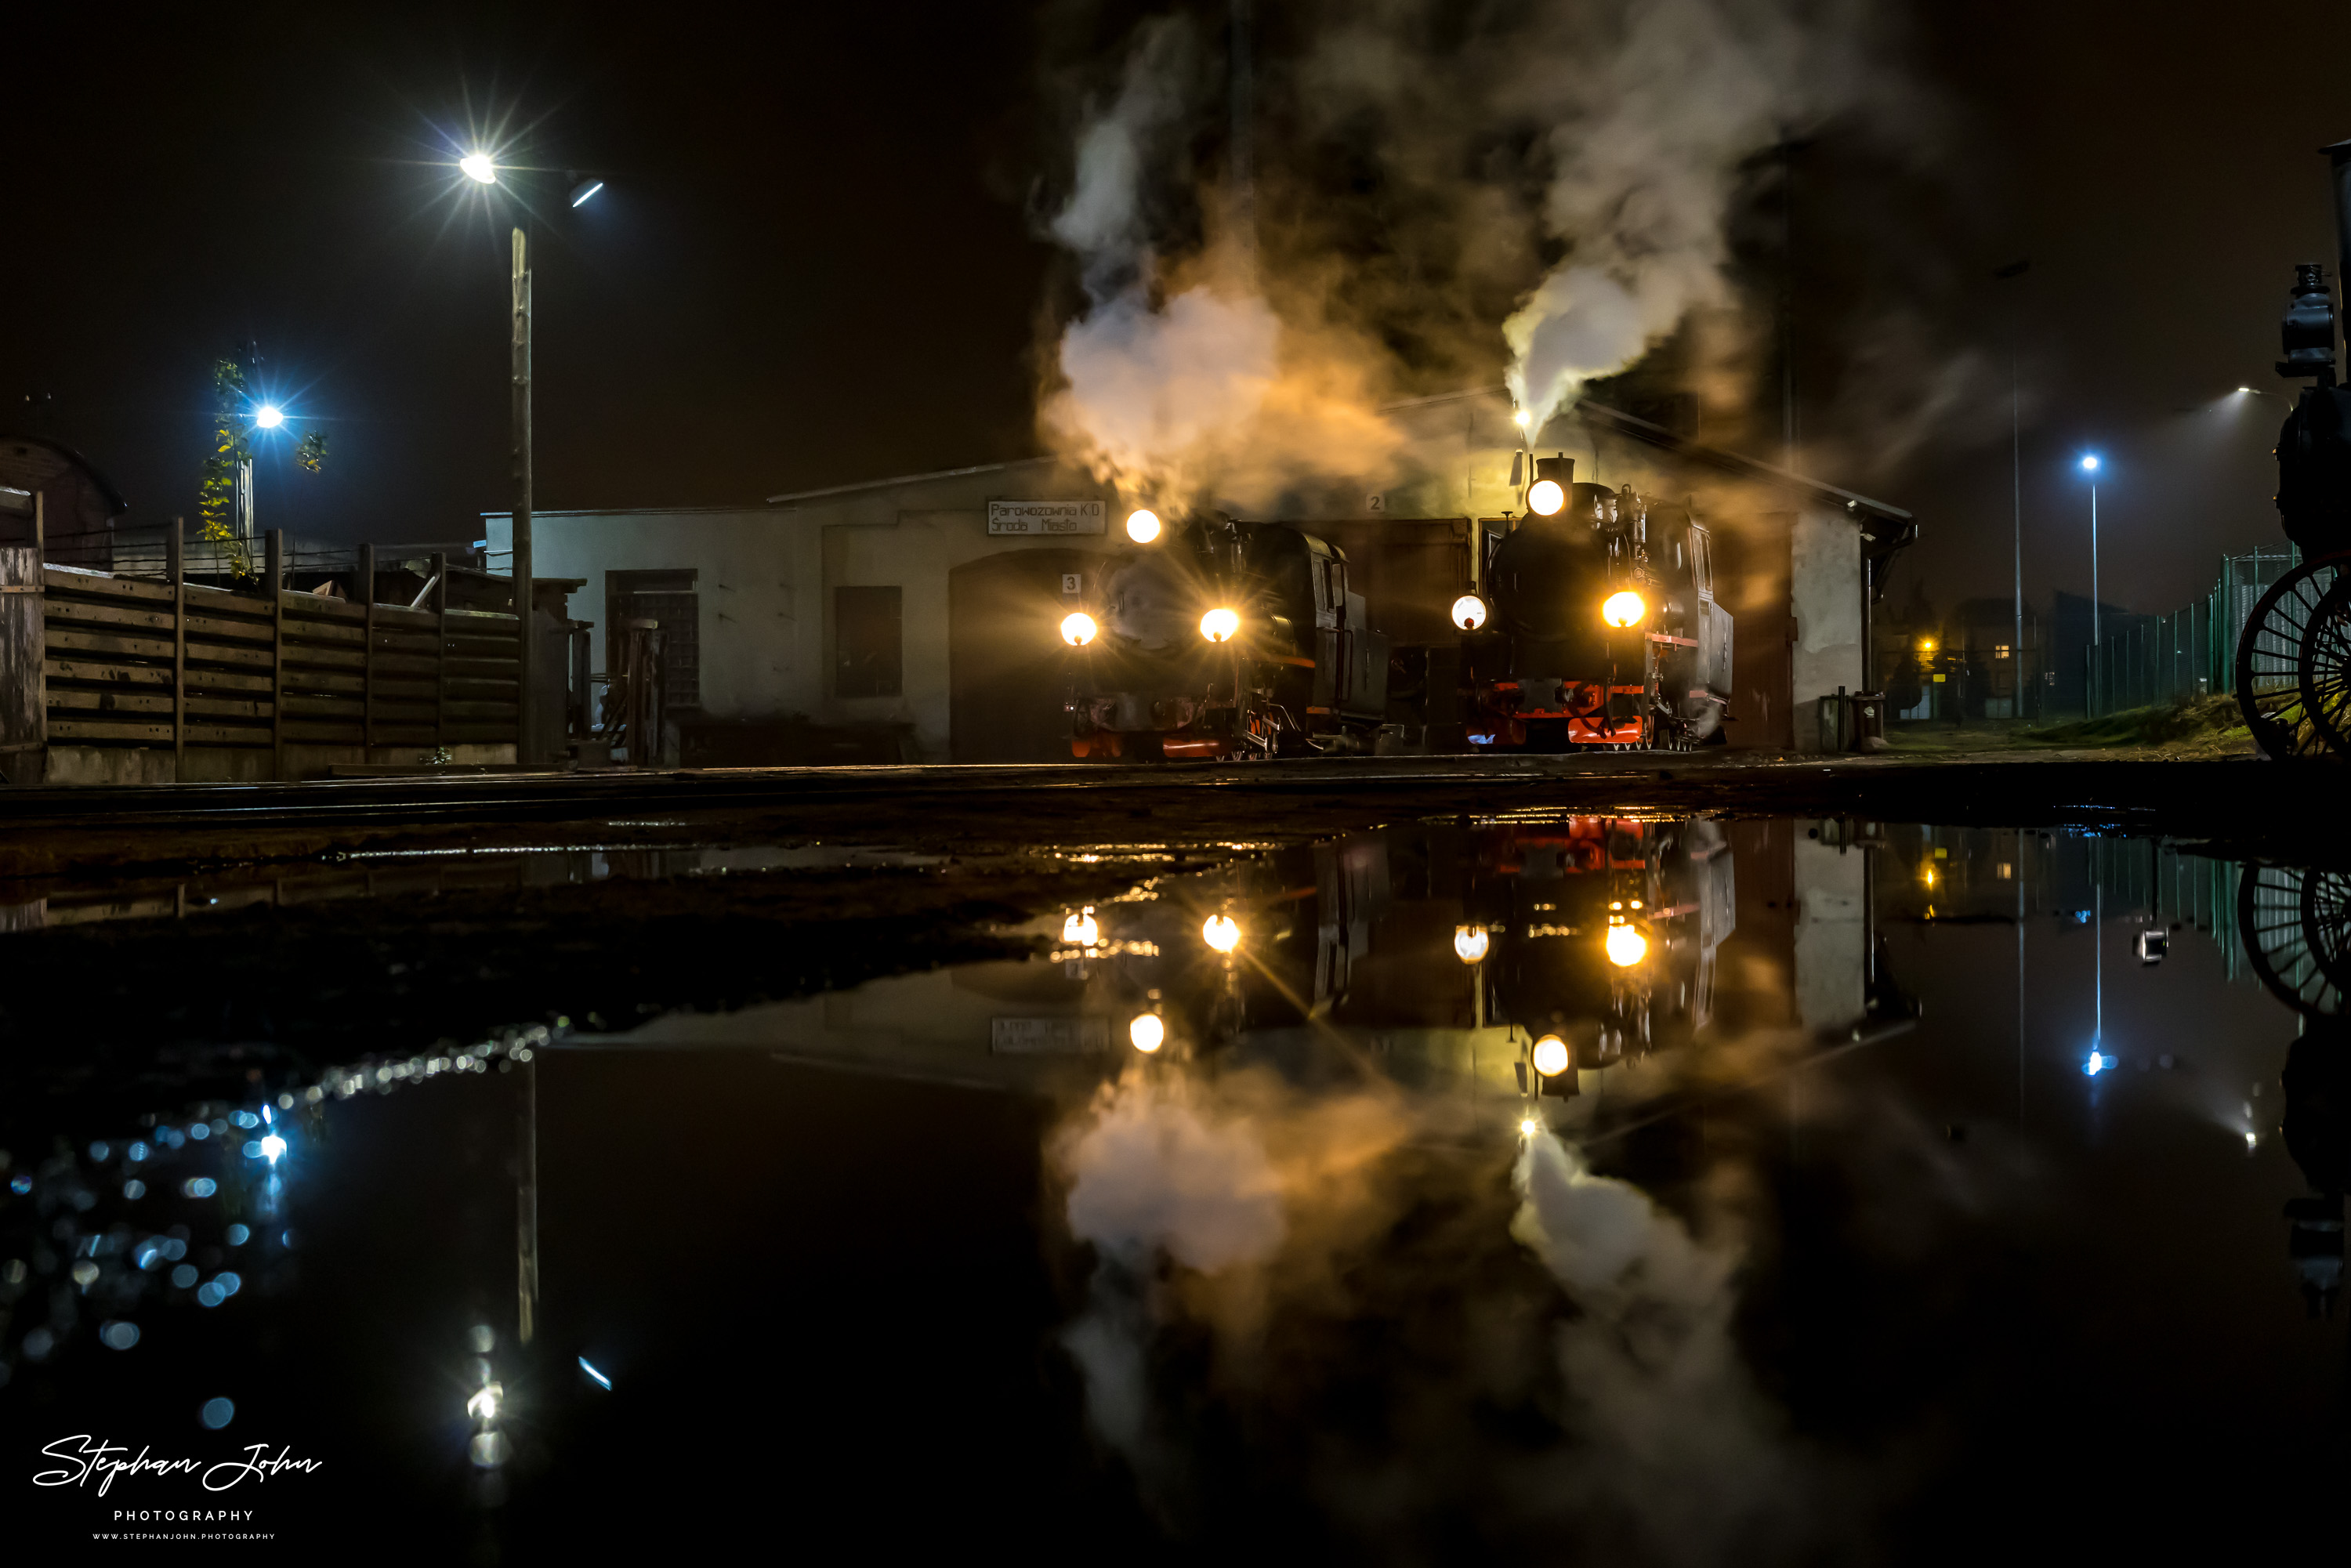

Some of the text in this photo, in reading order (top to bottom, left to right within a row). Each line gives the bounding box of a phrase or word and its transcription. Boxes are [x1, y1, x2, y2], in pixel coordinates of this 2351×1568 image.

[991, 503, 1077, 516] Parowozownia
[1371, 496, 1380, 510] 2
[991, 516, 1078, 531] Środa Miasto
[1067, 576, 1077, 590] 3
